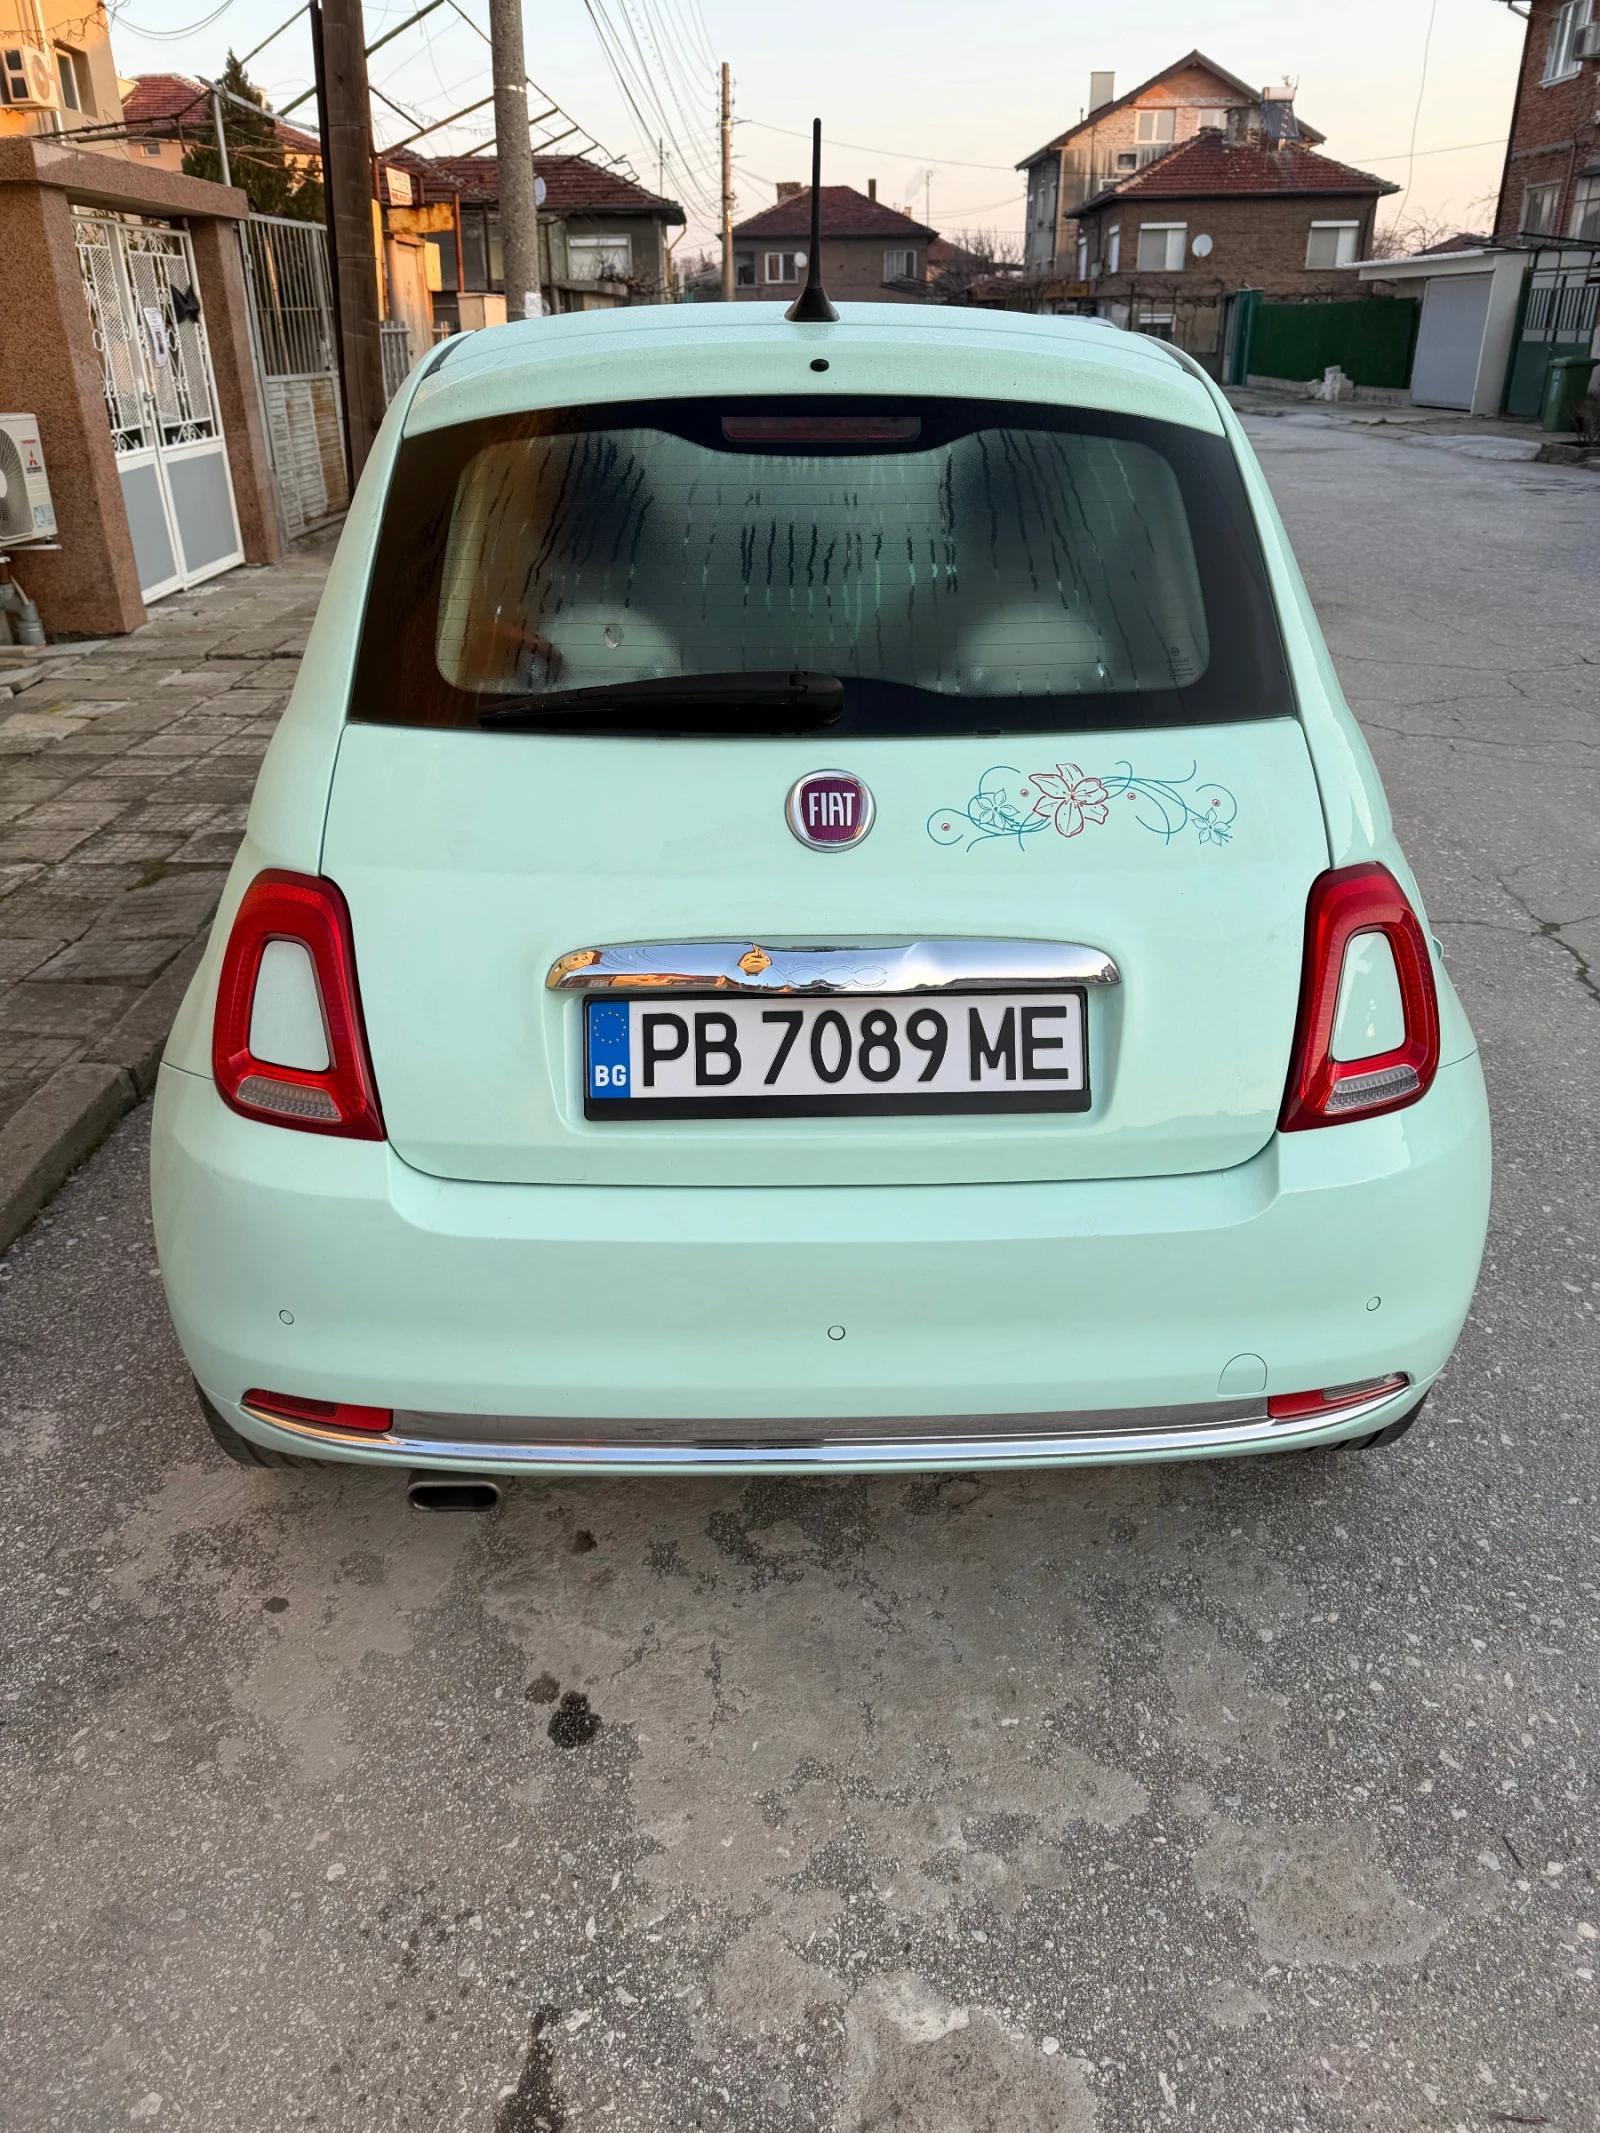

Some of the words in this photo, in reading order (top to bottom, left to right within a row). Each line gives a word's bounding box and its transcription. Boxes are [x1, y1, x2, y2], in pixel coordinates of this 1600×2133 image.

[808, 792, 856, 827] FIAT
[641, 1012, 742, 1087] PB
[762, 1008, 949, 1085] 7089
[969, 1006, 1069, 1082] ME
[595, 1064, 627, 1087] BG
